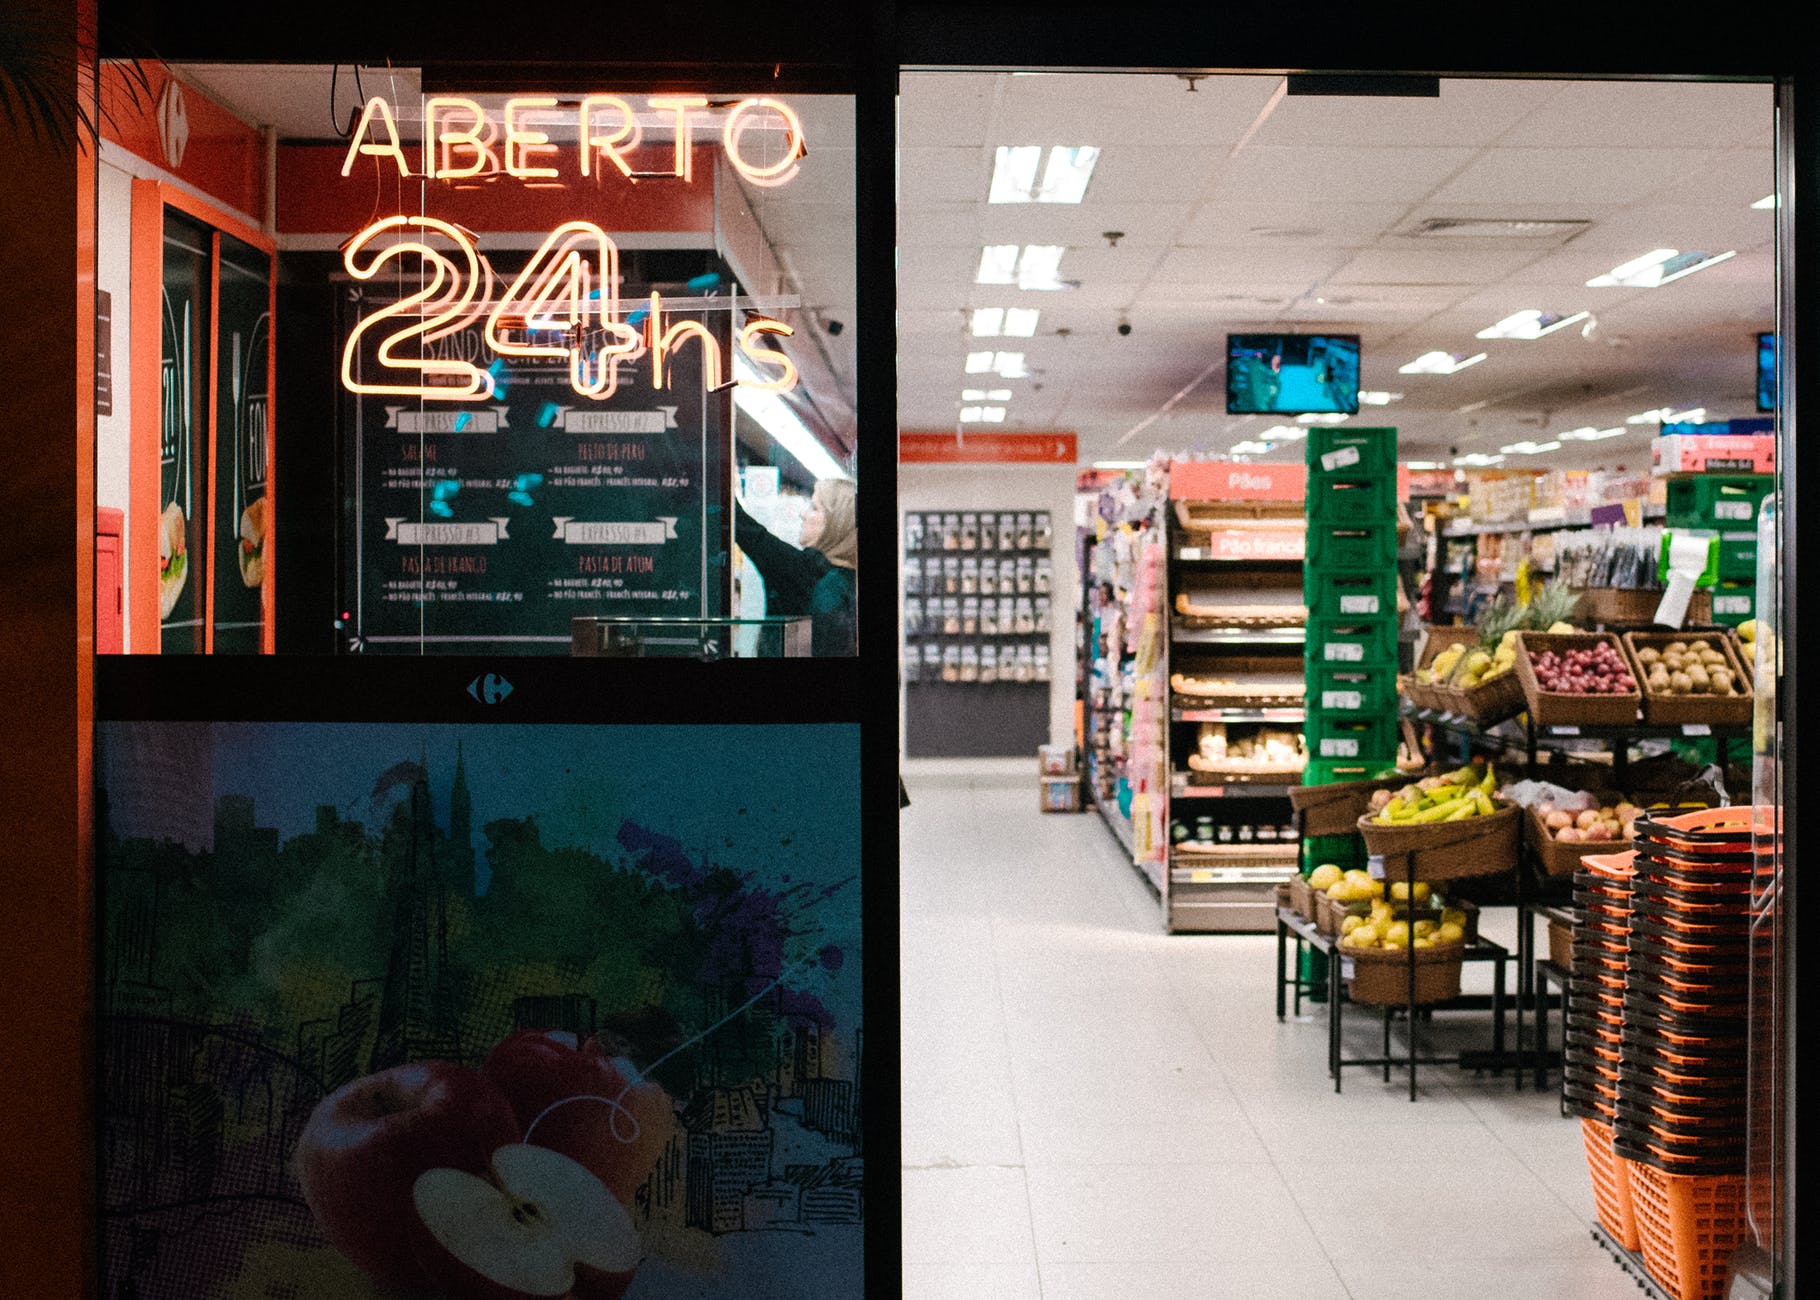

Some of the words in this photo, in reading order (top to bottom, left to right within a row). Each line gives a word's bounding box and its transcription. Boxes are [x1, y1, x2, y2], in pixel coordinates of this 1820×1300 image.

[341, 96, 803, 178] ABERTO
[1228, 471, 1272, 490] Pães
[581, 525, 630, 542] EXPRESSO
[1219, 538, 1251, 554] Pão
[402, 556, 431, 574] PASA
[579, 556, 608, 574] PASTA
[612, 556, 622, 573] DE
[626, 556, 653, 574] ATUM
